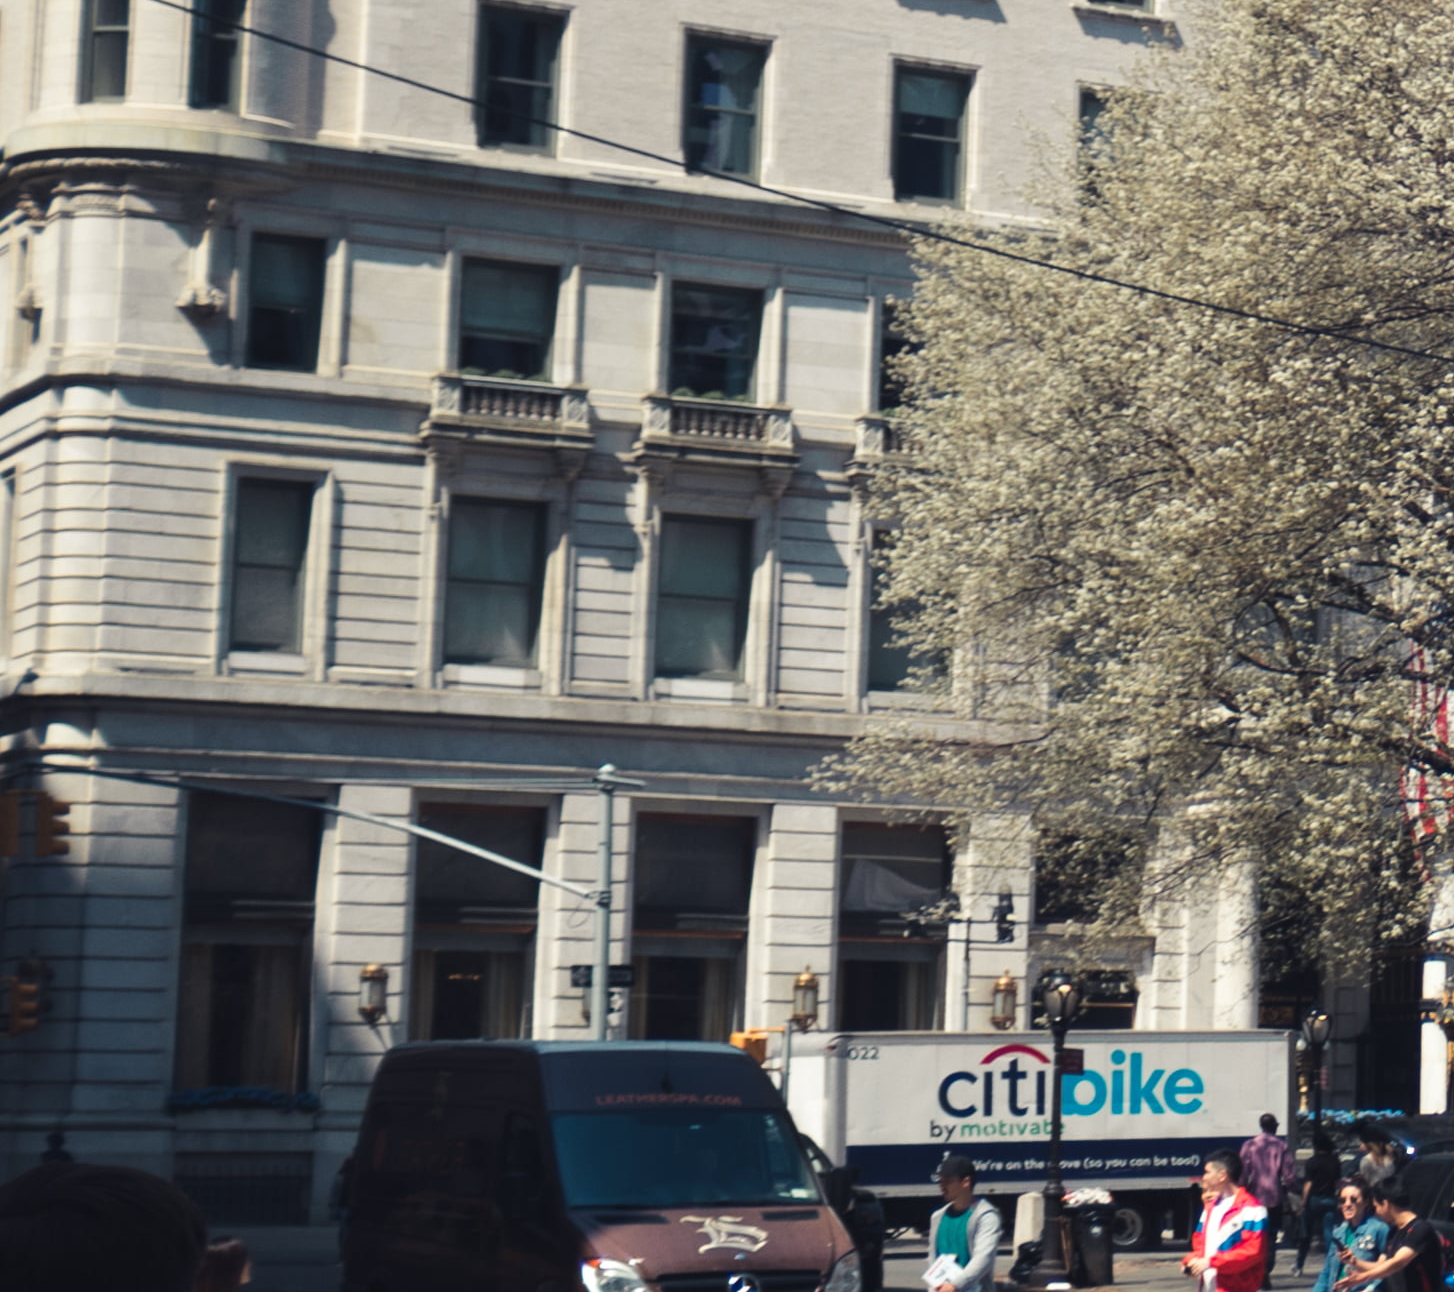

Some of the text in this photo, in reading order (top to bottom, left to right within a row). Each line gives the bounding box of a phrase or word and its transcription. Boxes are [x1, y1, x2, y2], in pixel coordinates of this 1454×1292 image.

[939, 1049, 1205, 1118] citi bike
[595, 1092, 743, 1107] LEATHERSPA.COM
[930, 1120, 956, 1143] by
[1005, 1161, 1021, 1171] on
[1024, 1158, 1045, 1170] the
[1047, 1161, 1081, 1171] ove
[1083, 1157, 1103, 1170] (so
[1104, 1158, 1128, 1171] you
[1129, 1158, 1151, 1168] can
[1153, 1156, 1168, 1167] be
